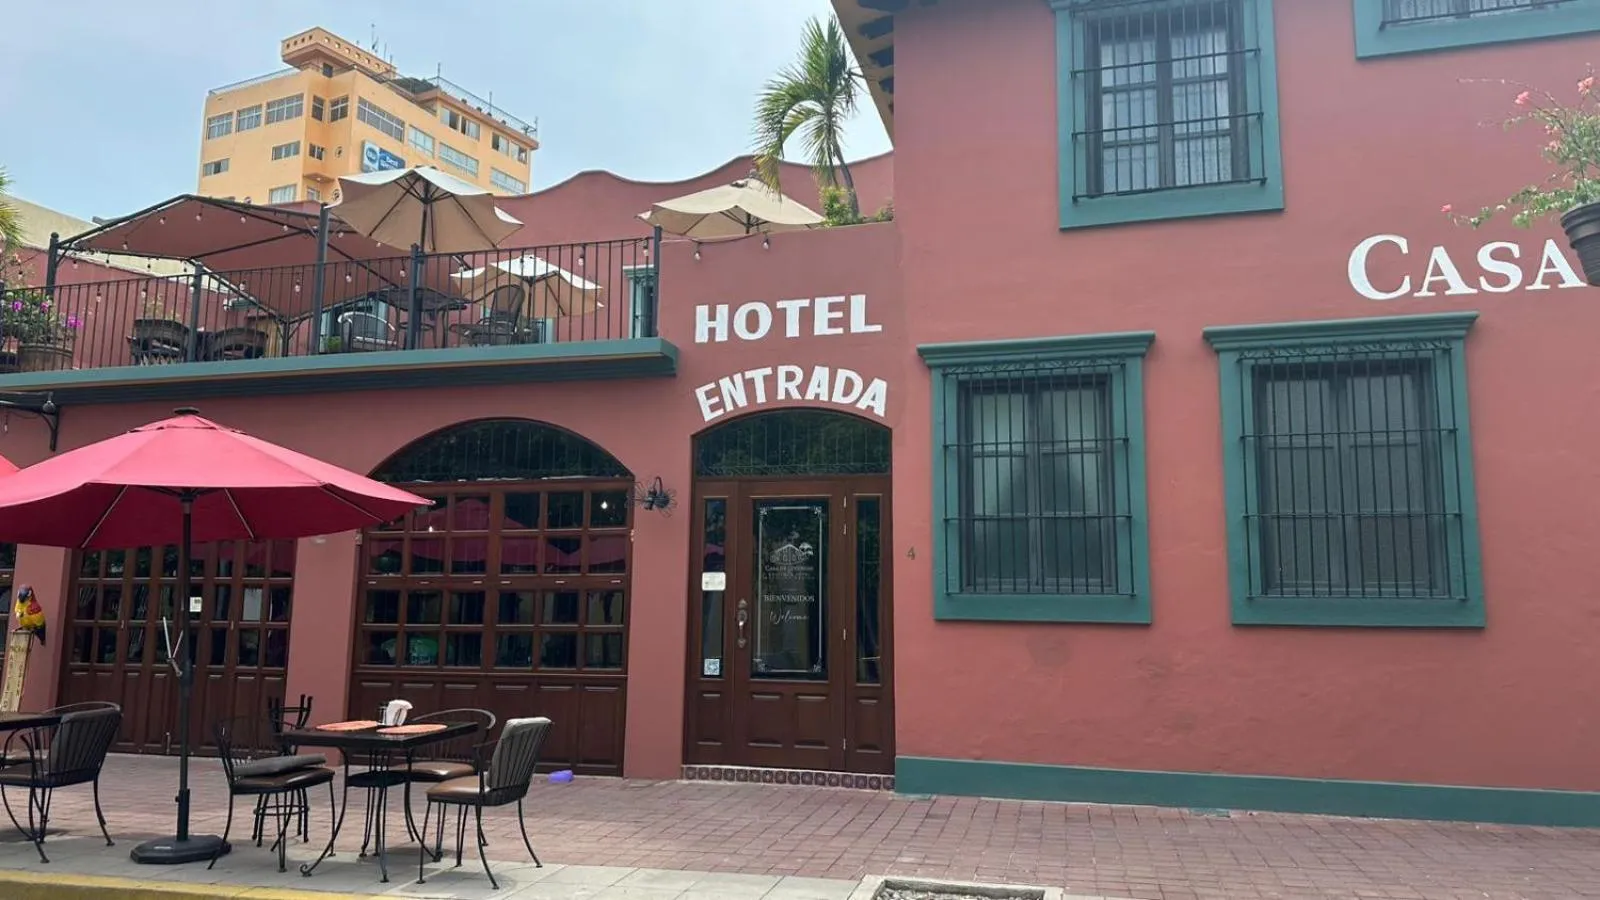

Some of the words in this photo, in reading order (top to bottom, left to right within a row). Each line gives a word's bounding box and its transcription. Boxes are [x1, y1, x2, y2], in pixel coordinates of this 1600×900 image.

[1347, 234, 1588, 300] CASA
[695, 294, 883, 343] HOTEL
[695, 365, 888, 422] ENTRADA
[906, 546, 916, 561] 4
[763, 594, 815, 603] BIENVENIDOS
